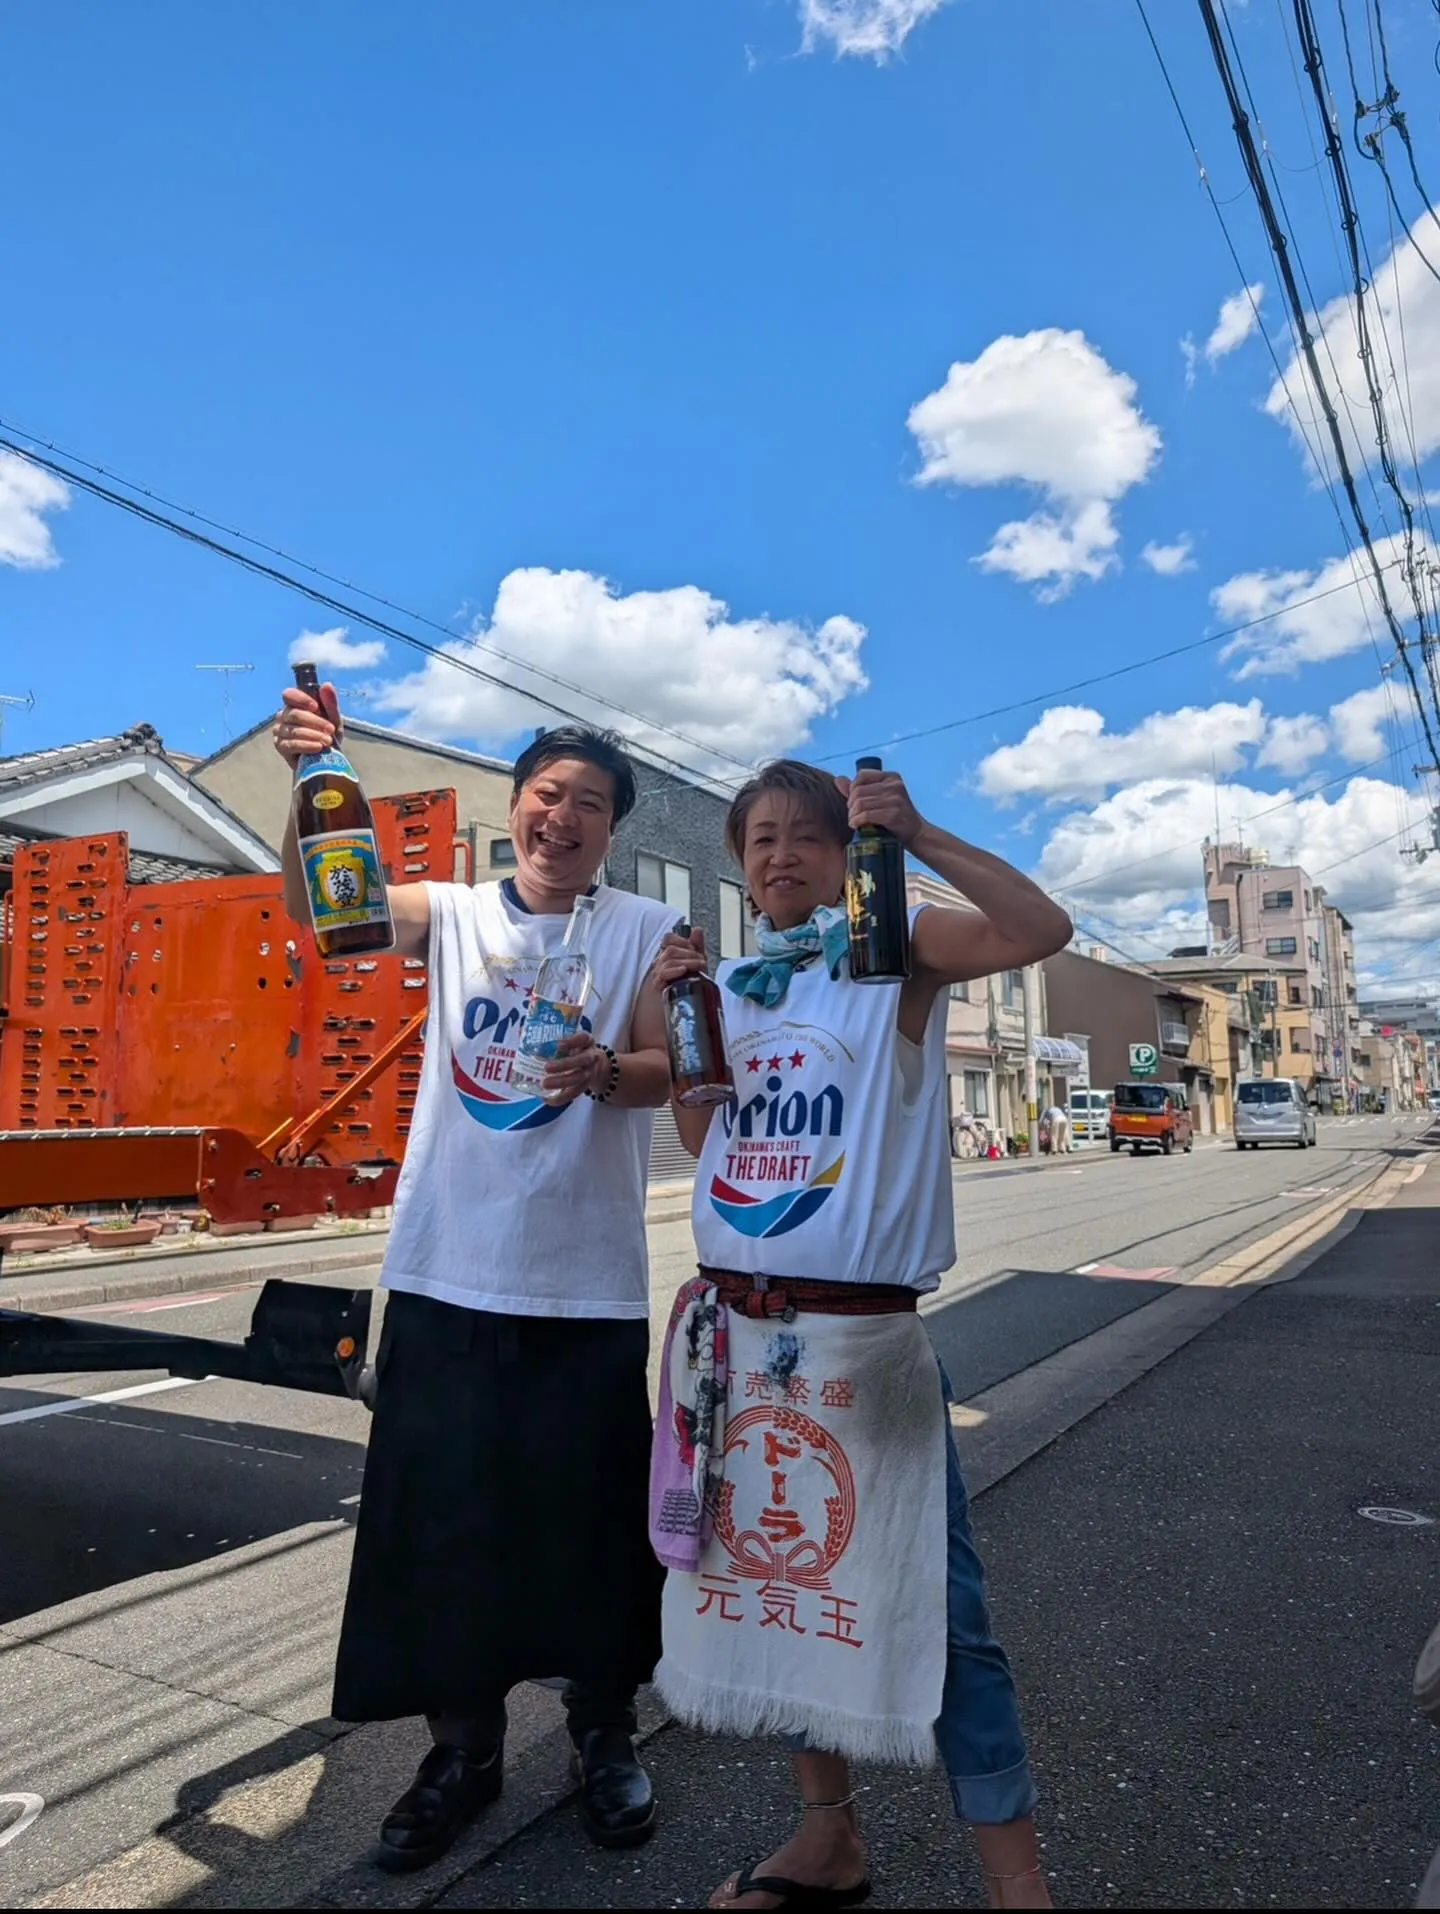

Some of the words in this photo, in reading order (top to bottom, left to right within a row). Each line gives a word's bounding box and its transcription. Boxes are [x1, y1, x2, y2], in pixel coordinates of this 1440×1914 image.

[782, 1032, 793, 1041] TO
[811, 1037, 835, 1063] WORLD
[1139, 1047, 1151, 1062] P
[473, 1056, 505, 1081] THE
[776, 1140, 800, 1152] CRAFT
[726, 1154, 757, 1179] THE
[757, 1155, 812, 1181] DRAFT
[696, 1573, 863, 1648] 元気玉
